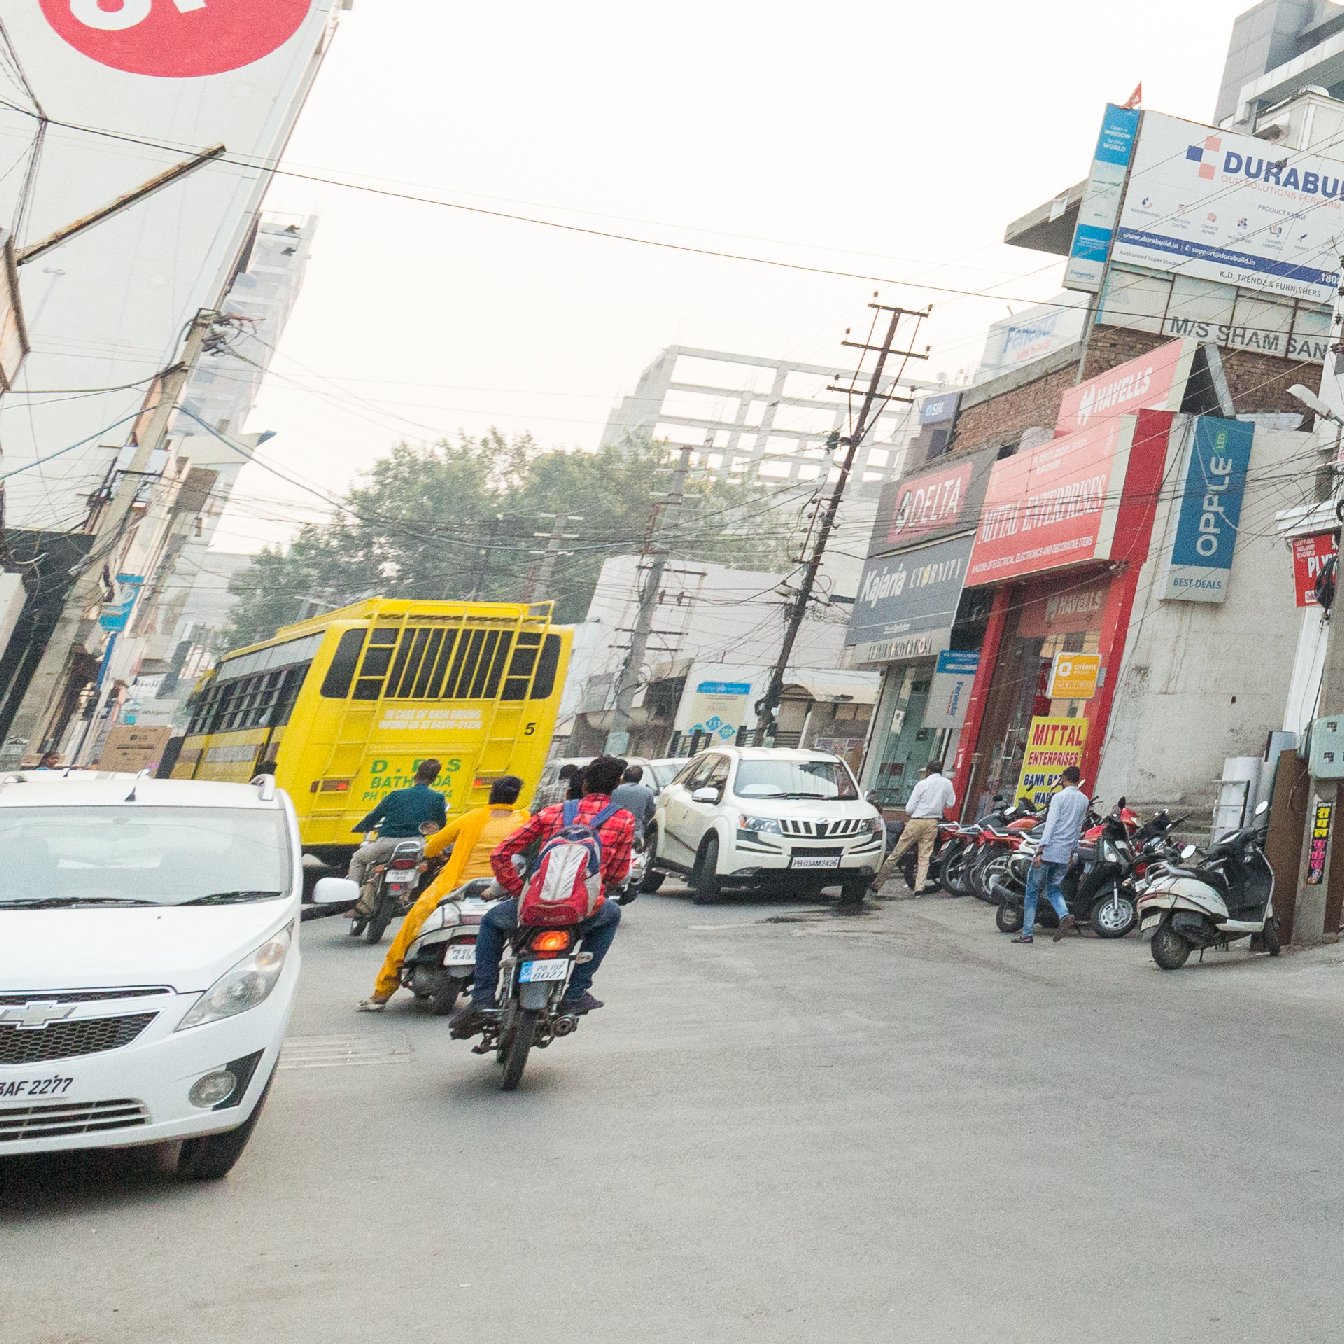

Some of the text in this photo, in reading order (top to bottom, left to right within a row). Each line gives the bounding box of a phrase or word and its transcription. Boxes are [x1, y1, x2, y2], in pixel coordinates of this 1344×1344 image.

[1103, 142, 1126, 153] WORLD
[1246, 179, 1297, 201] SOLUTIONS
[1258, 204, 1285, 216] PRODUCT
[1123, 233, 1256, 266] www.durabuild.in support@durabuild.in
[1220, 270, 1236, 281] K.D.
[1275, 282, 1321, 299] FURNISHERS
[1170, 316, 1280, 351] M/S SHAM
[1093, 366, 1153, 413] HAVELLS
[1217, 433, 1226, 449] LED
[908, 476, 962, 528] DELTA
[978, 475, 1107, 545] MITTAL ENTERPRISES
[1196, 456, 1233, 557] OPPLE
[1074, 662, 1097, 672] orient
[525, 722, 536, 736] 5
[1032, 724, 1082, 747] MITTAL
[1028, 752, 1080, 767] ENTERPRISES
[1024, 774, 1045, 787] BANK
[28, 1077, 74, 1096] 2277
